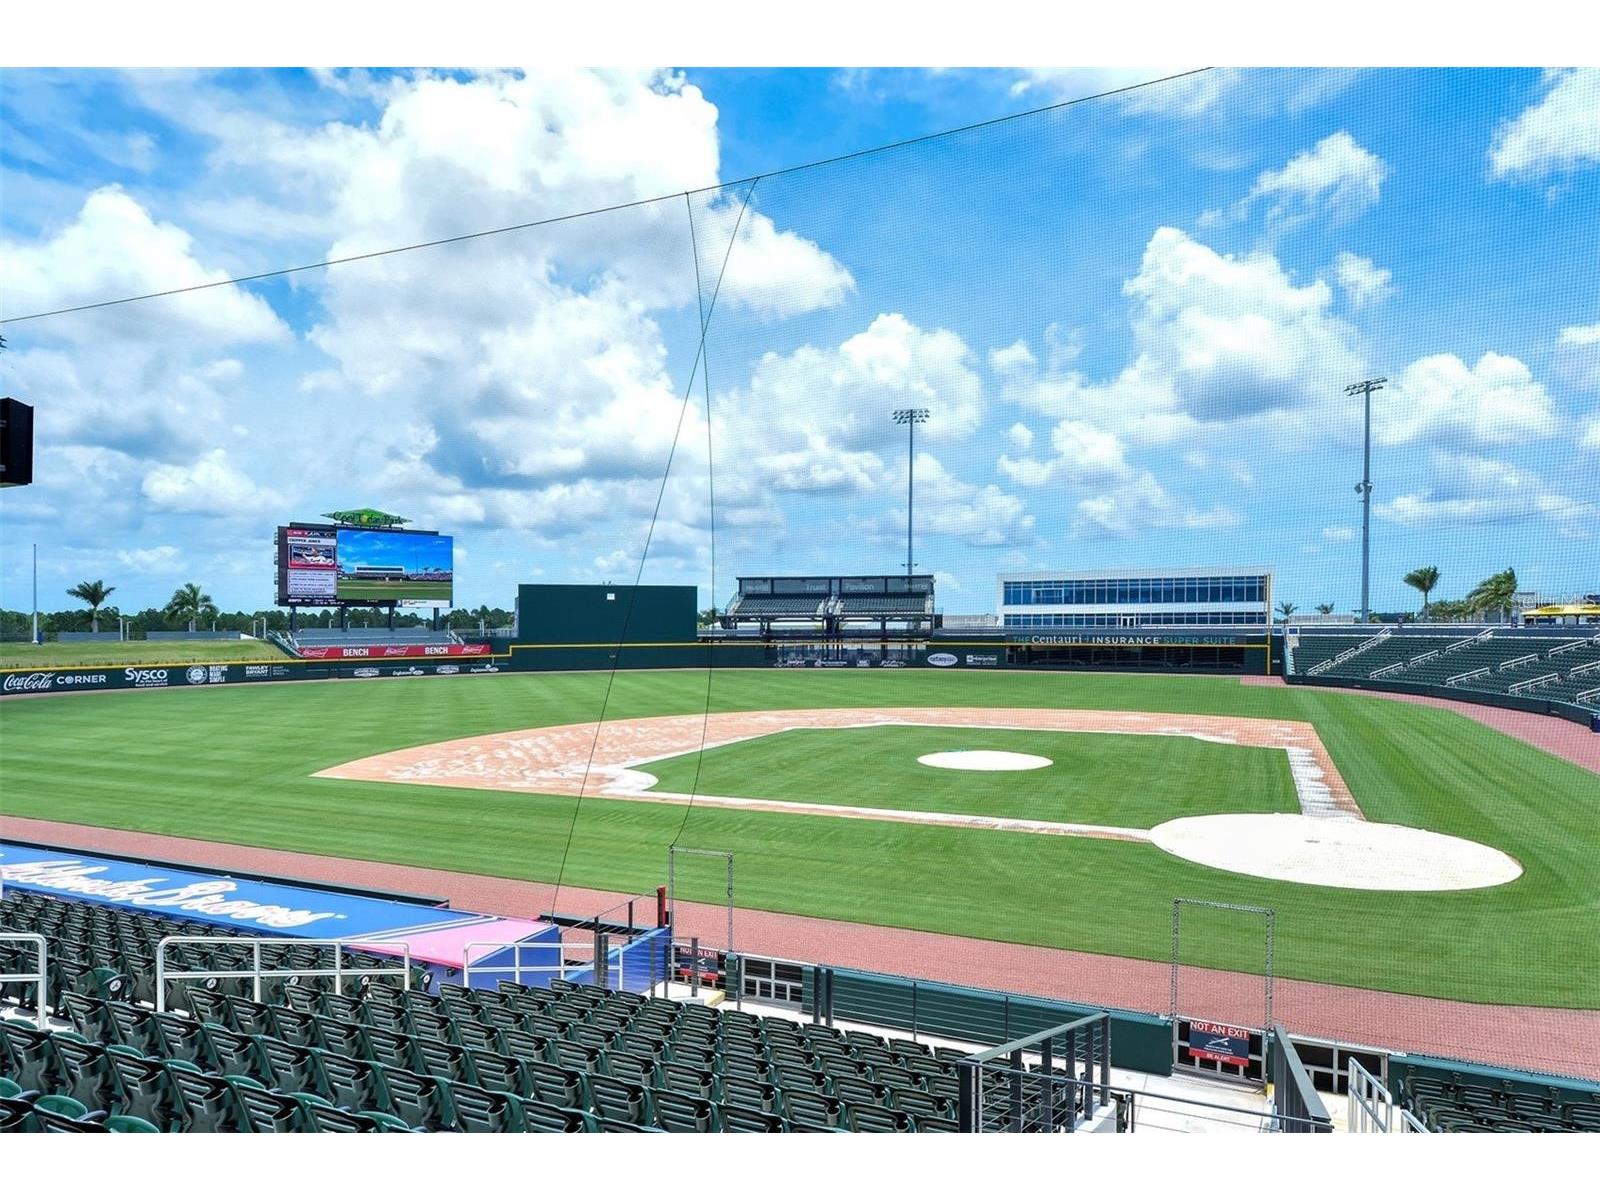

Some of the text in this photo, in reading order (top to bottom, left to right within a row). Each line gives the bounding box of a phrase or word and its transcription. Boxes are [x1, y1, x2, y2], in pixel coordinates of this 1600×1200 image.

[1031, 634, 1082, 644] Centauri
[1092, 636, 1161, 645] INSURANCE
[1163, 637, 1199, 645] SUPER
[1203, 637, 1236, 645] SUITE
[342, 648, 369, 657] BENCH
[424, 646, 449, 655] BENCH
[56, 674, 107, 685] CORNER
[124, 667, 168, 682] Sysco
[1190, 1021, 1249, 1039] NOT AN EXIT
